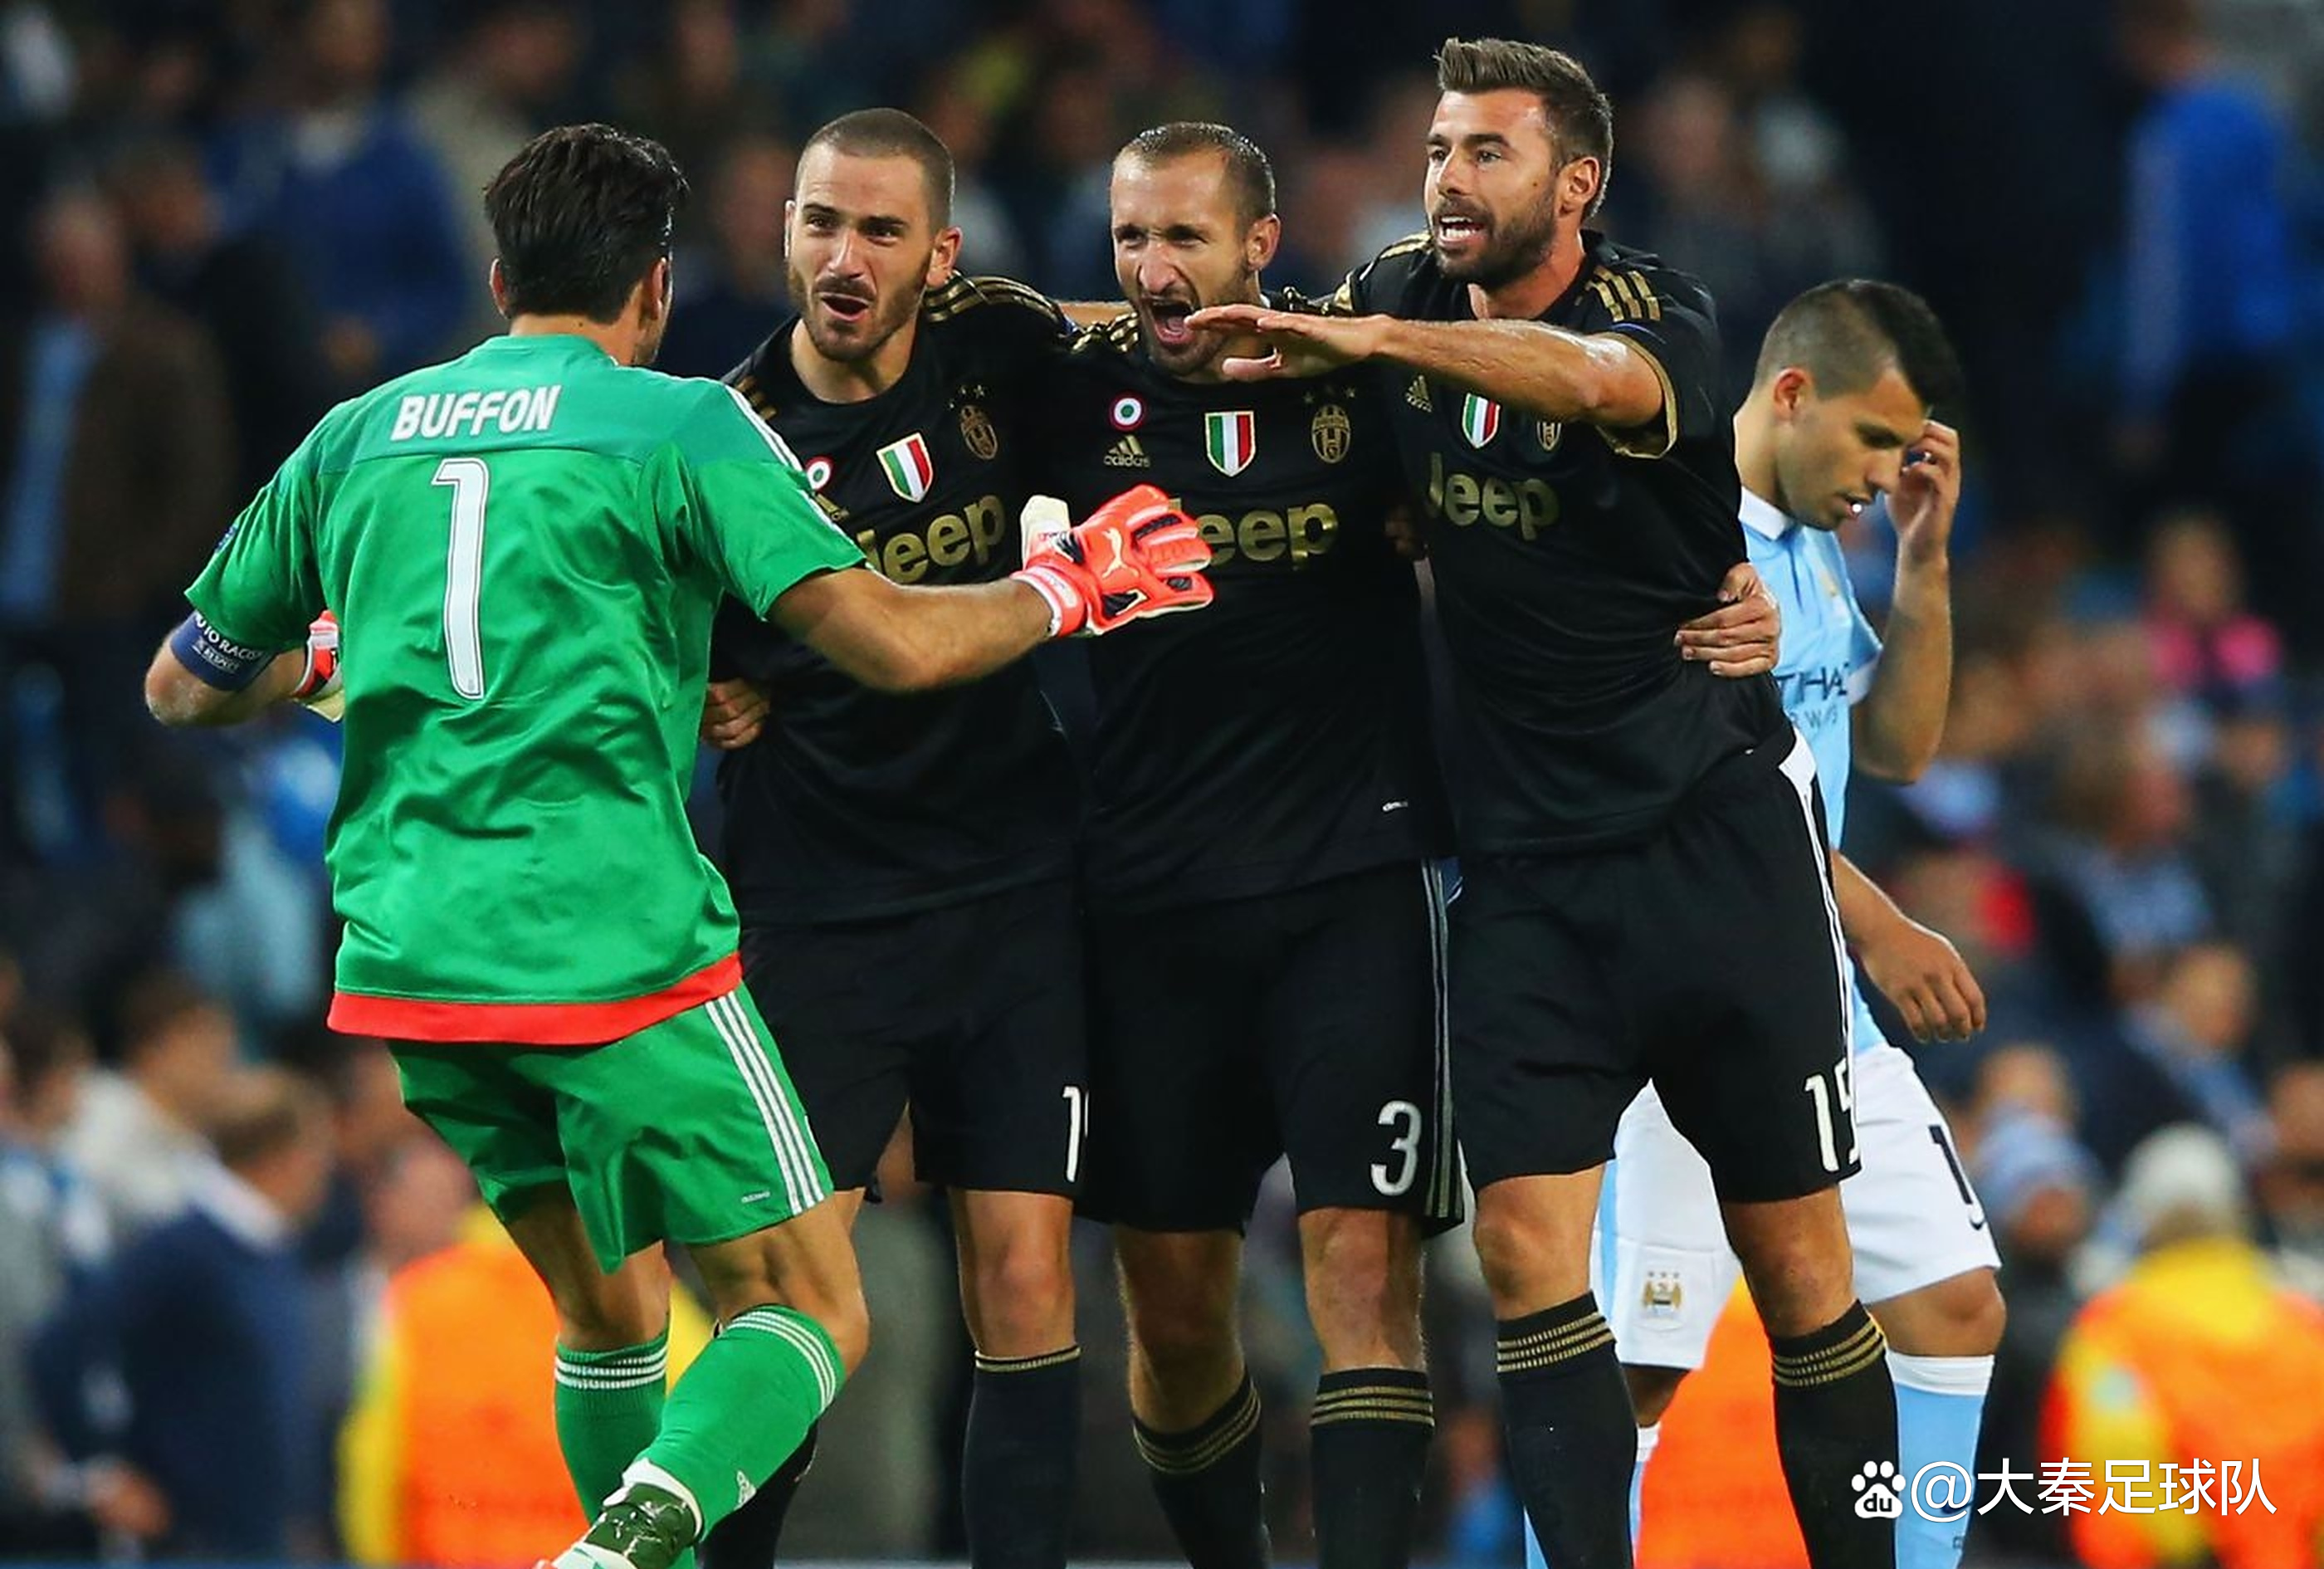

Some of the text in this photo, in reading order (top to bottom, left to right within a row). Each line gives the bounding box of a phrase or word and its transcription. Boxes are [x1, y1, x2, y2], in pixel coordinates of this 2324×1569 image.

[390, 385, 561, 442] BUFFON
[1168, 498, 1338, 571] eep
[1427, 452, 1560, 541] Jeep
[431, 457, 489, 699] 1
[1062, 1086, 1089, 1182] 1
[1370, 1100, 1422, 1195] 3
